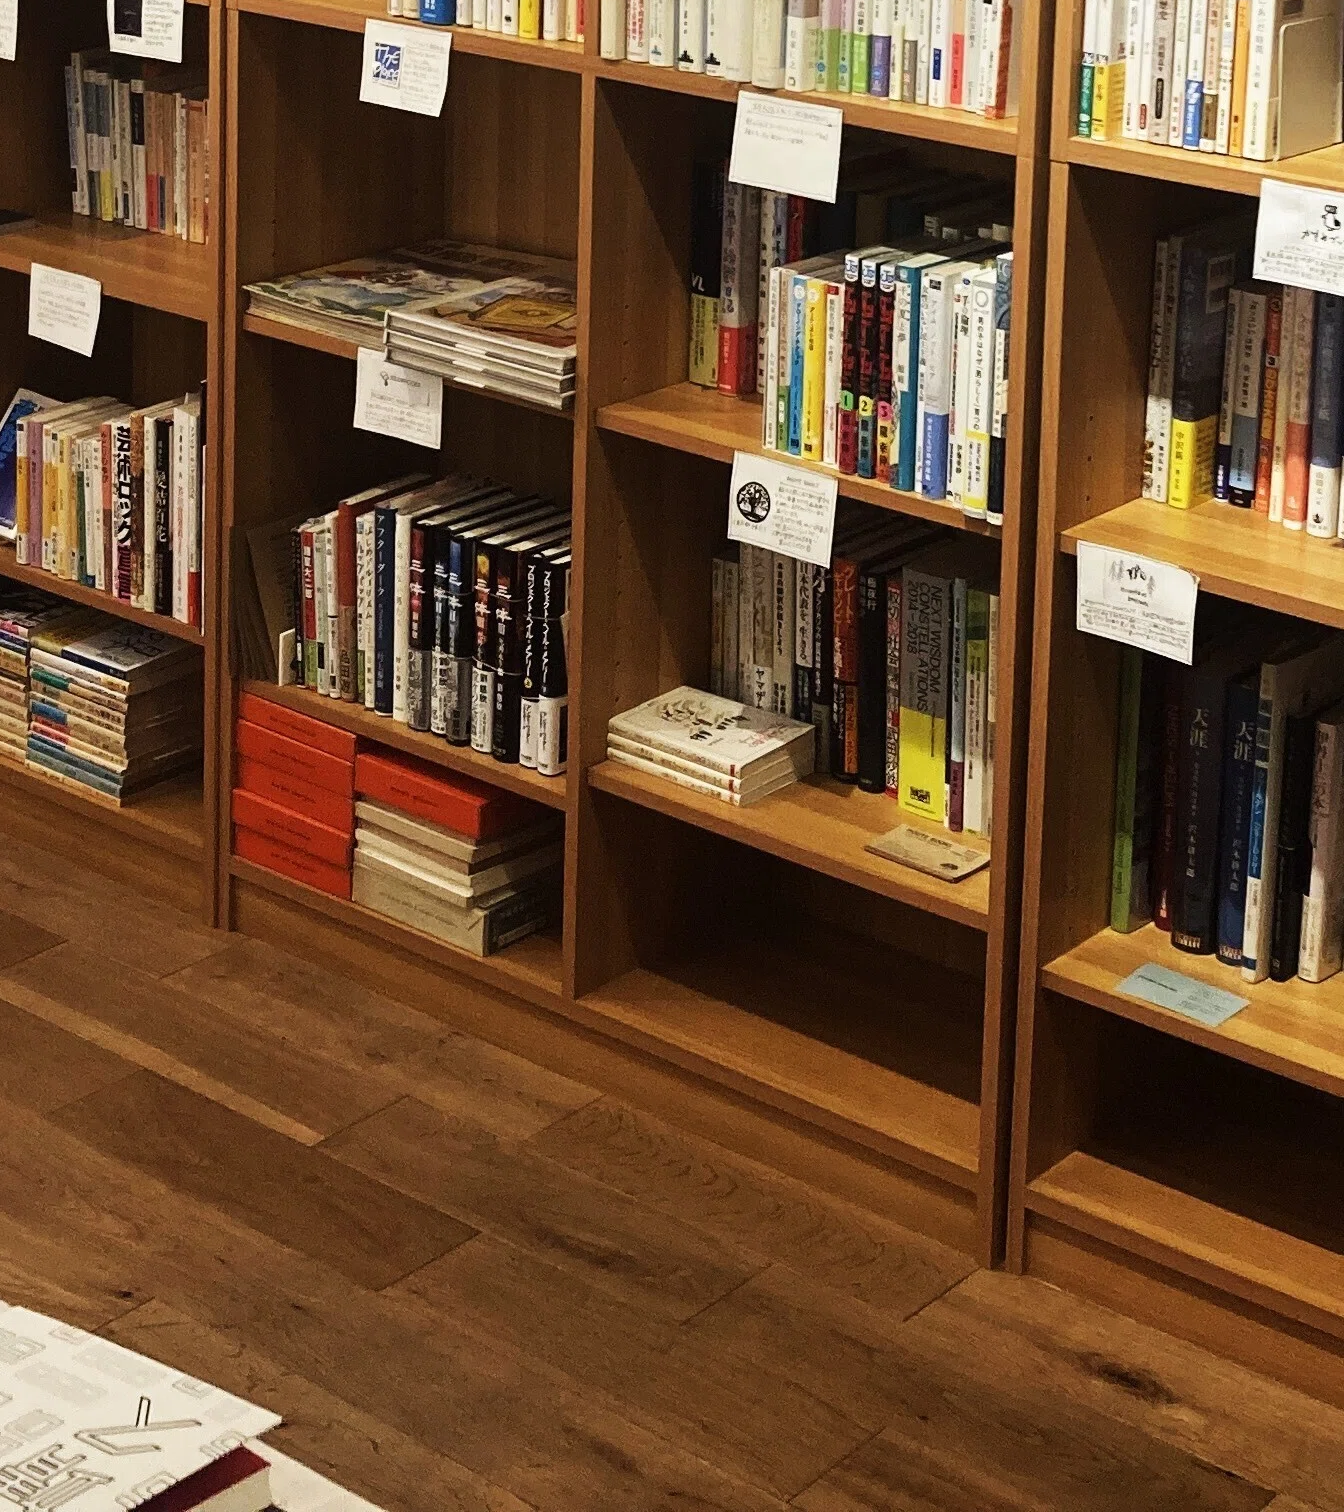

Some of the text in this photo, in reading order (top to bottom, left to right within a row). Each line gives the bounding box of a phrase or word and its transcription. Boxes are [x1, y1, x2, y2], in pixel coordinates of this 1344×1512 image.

[843, 392, 853, 410] 1
[861, 399, 870, 412] 2
[116, 425, 132, 546] 芸術ロック
[375, 513, 386, 597] アフターダーク
[907, 580, 918, 610] 2014
[906, 622, 918, 656] 2018
[917, 581, 932, 714] CONSTELLATIONS
[928, 584, 943, 694] NEXT WISDOM
[1189, 706, 1210, 750] 天涯
